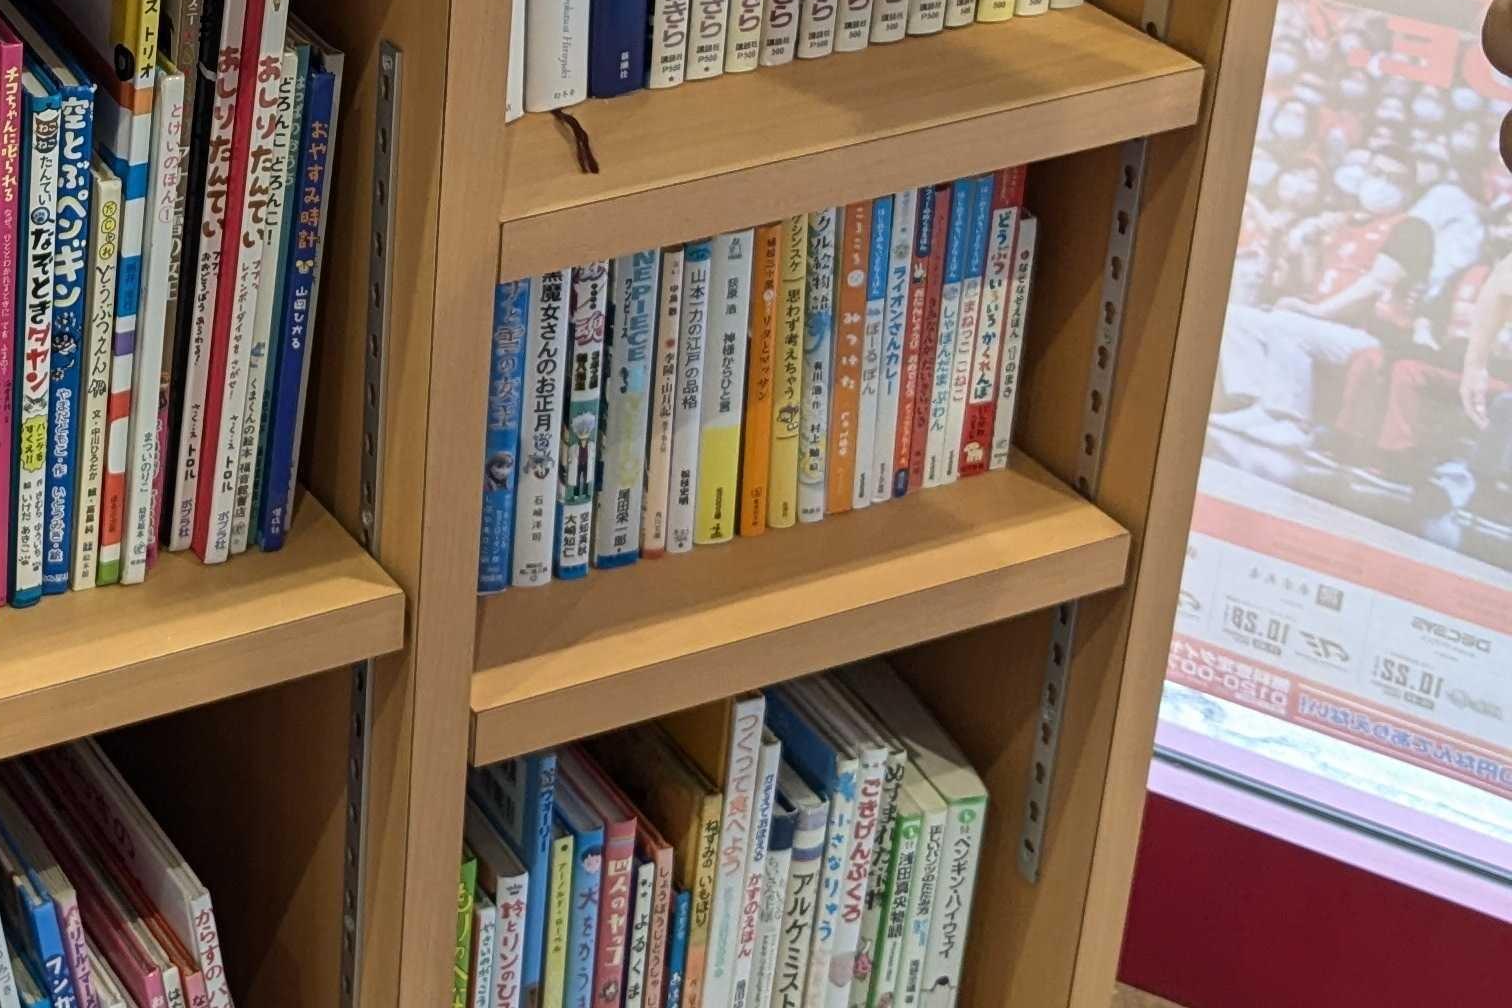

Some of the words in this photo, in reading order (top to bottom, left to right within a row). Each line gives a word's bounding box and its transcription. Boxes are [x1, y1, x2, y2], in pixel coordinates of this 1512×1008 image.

[140, 29, 156, 80] トリオ
[273, 76, 294, 147] どろんこ
[2, 67, 20, 203] チコちゃんに叱られる
[39, 156, 53, 204] たんてい
[202, 46, 240, 238] おしりたんてい
[242, 56, 282, 249] おしりたんてい
[297, 120, 328, 249] おやすみ時計
[55, 97, 90, 308] 空とぶペンギン
[29, 228, 54, 325] なぞとき
[92, 264, 114, 374] どうぶつえん
[291, 286, 308, 350] 山岡ひかる
[885, 265, 907, 395] ライオンさんカレー
[681, 268, 706, 410] 山本一力の江戸の品格
[783, 289, 803, 400] 思わず考えちゃう
[185, 443, 196, 482] トロル
[222, 455, 233, 492] トロル
[779, 873, 815, 1008] アルケミスト
[939, 836, 970, 959] ペンギン・ハイウェイ
